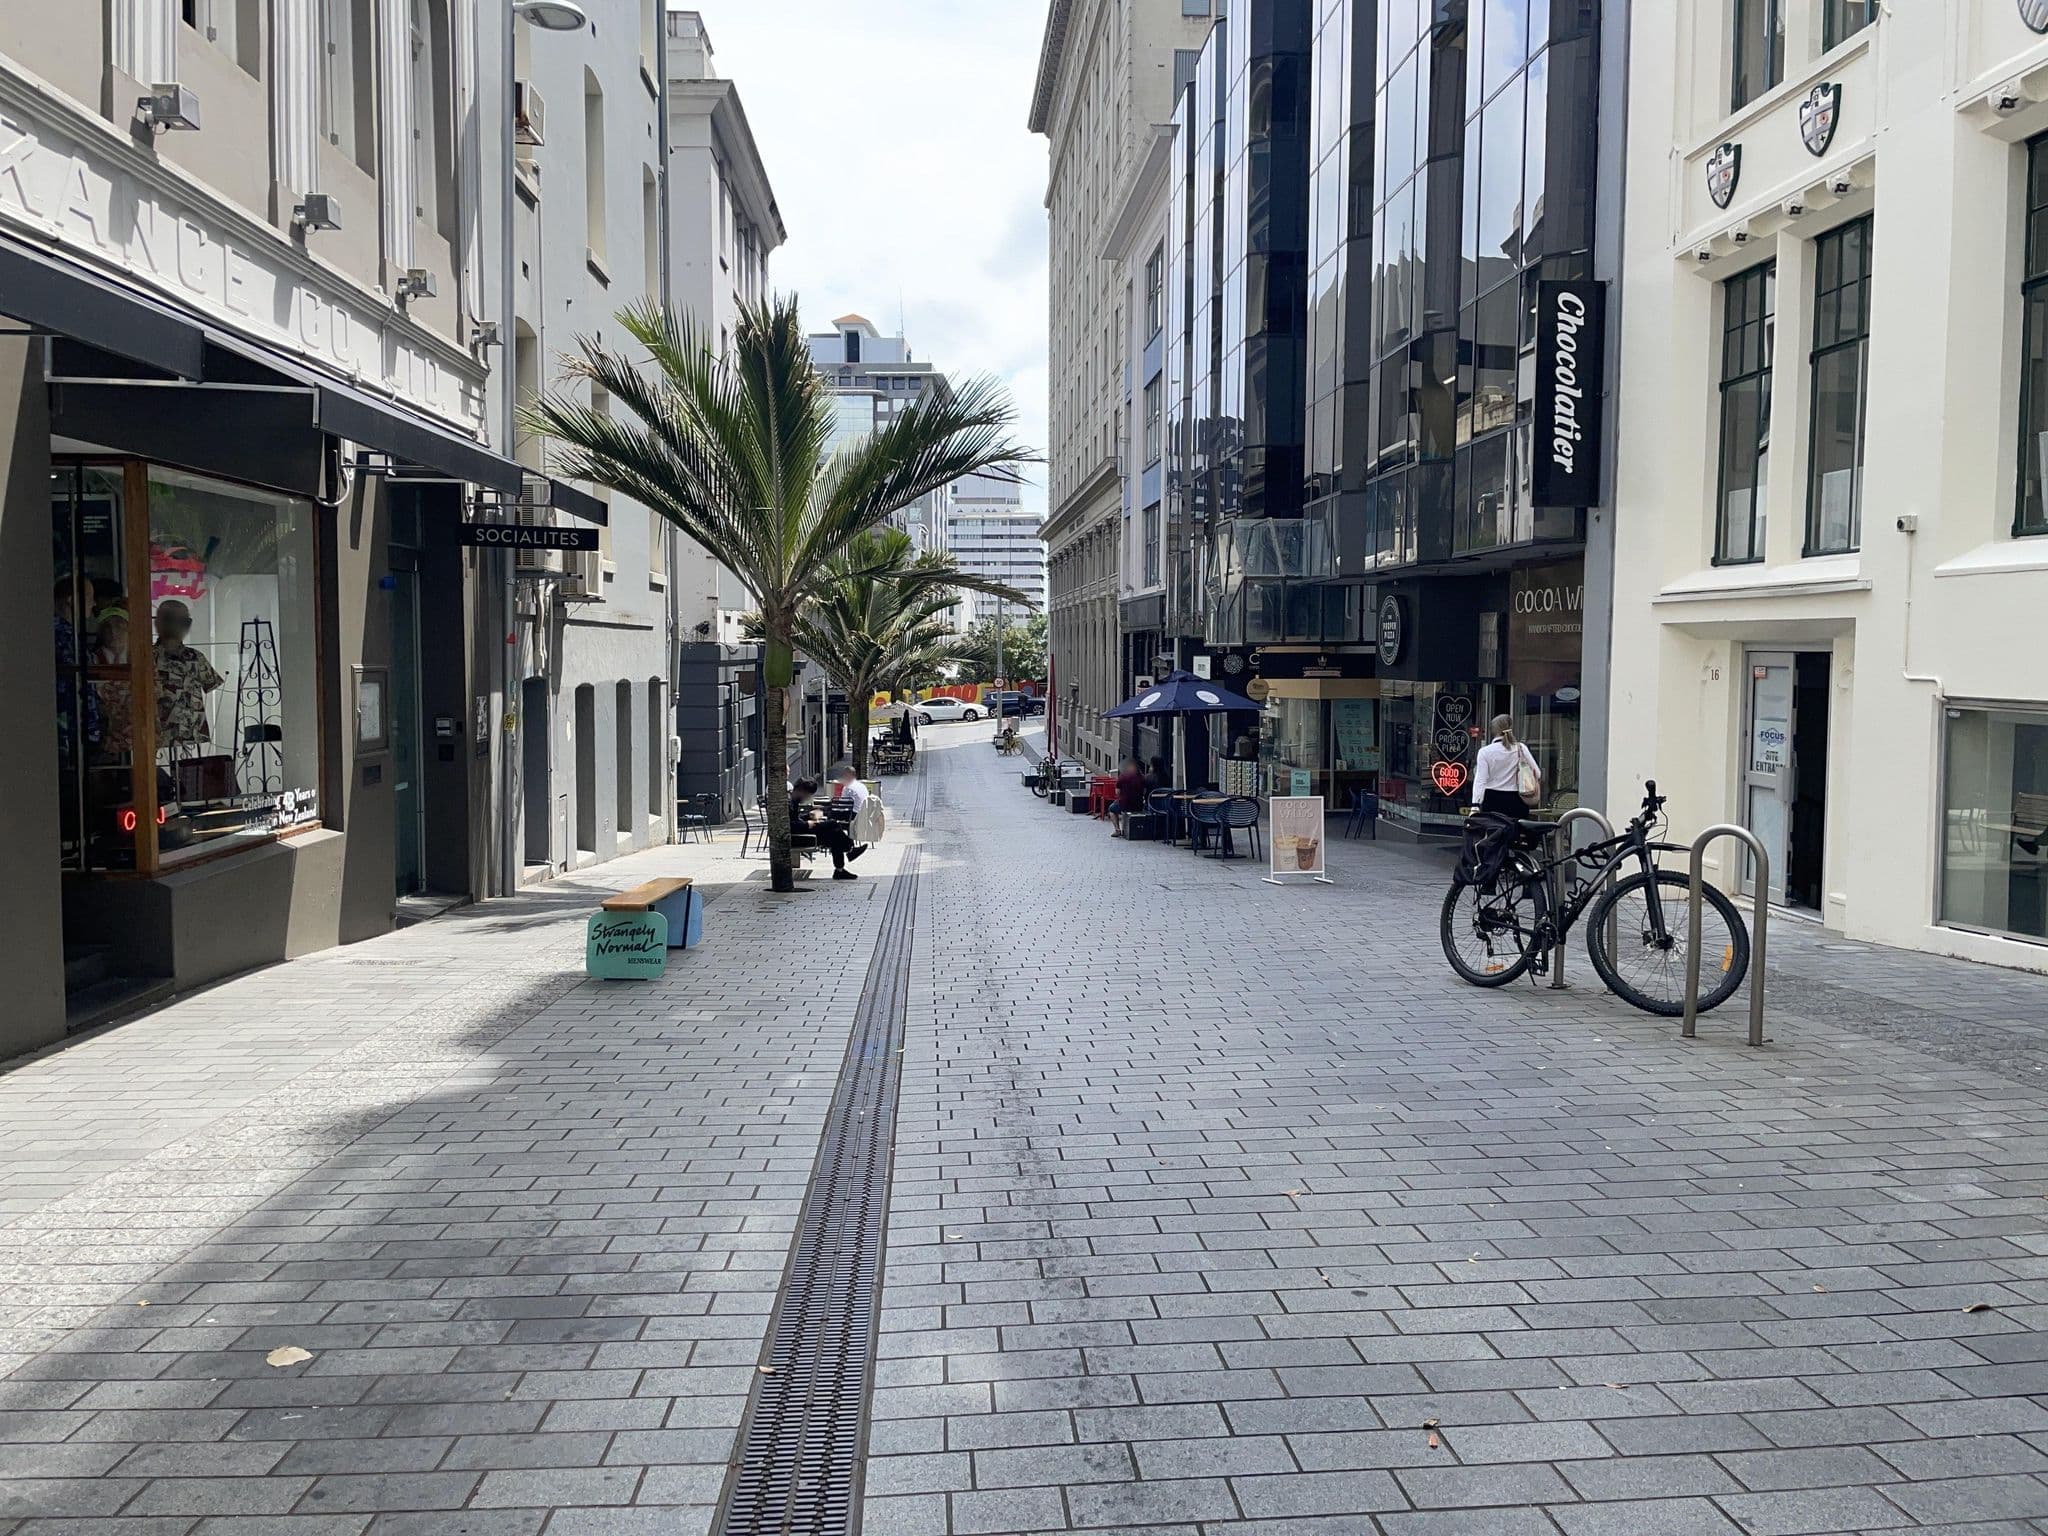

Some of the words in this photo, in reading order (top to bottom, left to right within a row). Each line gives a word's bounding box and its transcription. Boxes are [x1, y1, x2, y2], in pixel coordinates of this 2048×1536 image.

[1553, 291, 1586, 474] Chocolatier
[475, 528, 580, 546] SOCIALITES
[1515, 587, 1562, 613] COCOA
[1711, 668, 1720, 681] 16
[1446, 703, 1464, 714] OPEN
[1446, 713, 1462, 722] NOW
[1439, 734, 1466, 745] PROPER
[1760, 730, 1785, 741] FOCUS
[1441, 746, 1461, 754] PIZZA
[1765, 749, 1779, 762] SITE
[1439, 767, 1460, 778] GOOD
[1439, 777, 1459, 788] TIMES
[242, 794, 281, 812] Celebrating
[295, 787, 311, 802] Years
[279, 811, 294, 825] New
[294, 803, 317, 823] Zealand
[591, 921, 656, 943] Strangely
[596, 939, 663, 957] Normal
[627, 957, 662, 965] MENSWEAR
